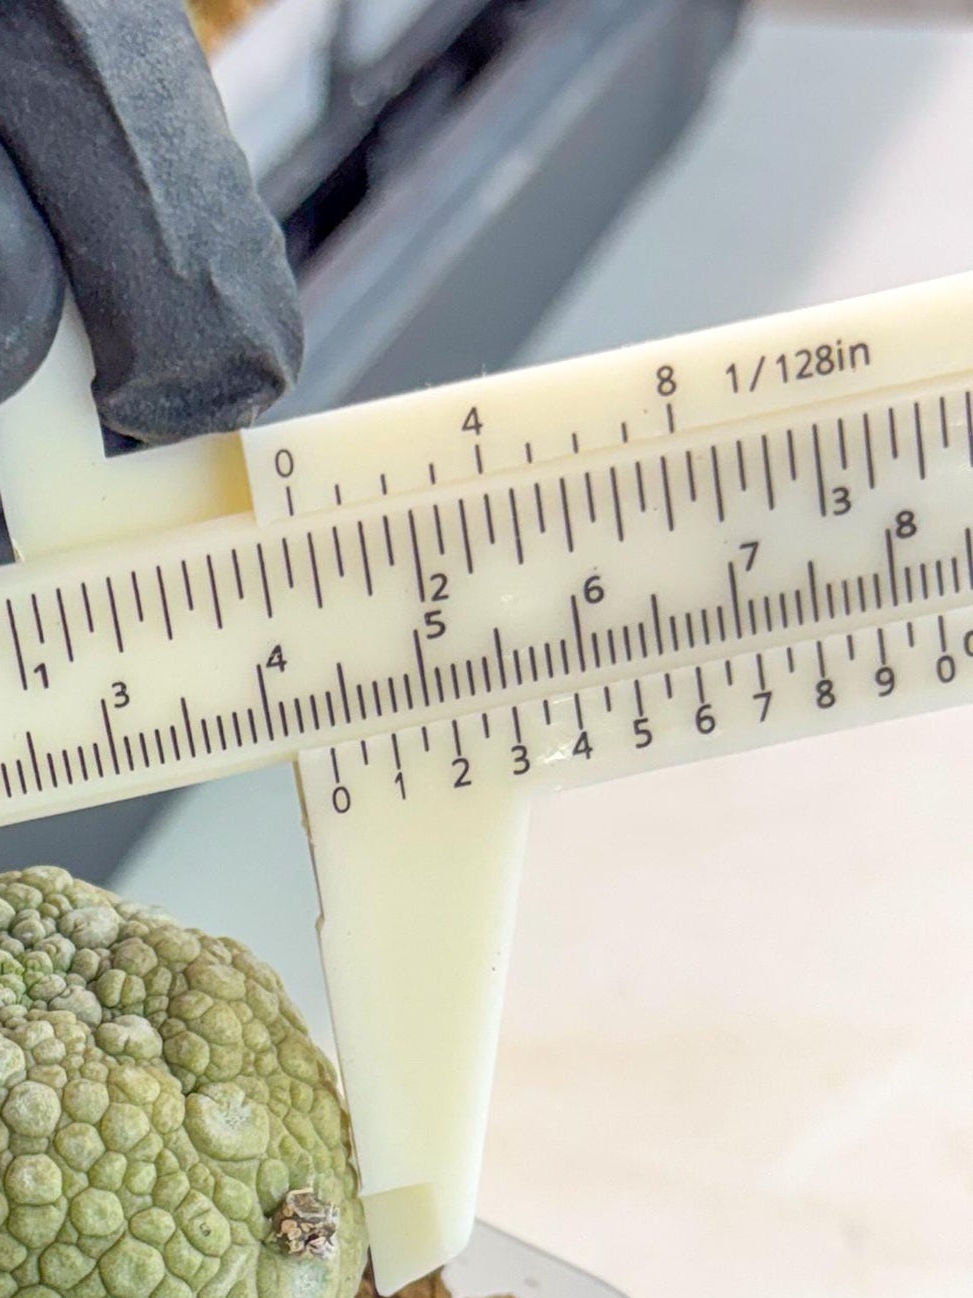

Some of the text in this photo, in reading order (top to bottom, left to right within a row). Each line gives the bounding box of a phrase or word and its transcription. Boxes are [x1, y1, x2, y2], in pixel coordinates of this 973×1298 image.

[274, 448, 295, 479] 0
[461, 406, 484, 436] 4
[655, 364, 678, 397] 8
[33, 662, 50, 690] 1
[429, 572, 450, 602] 2
[832, 486, 852, 517] 3
[111, 680, 131, 709] 3
[265, 643, 288, 673] 4
[423, 609, 447, 640] 5
[582, 574, 605, 605] 6
[738, 540, 760, 572] 7
[894, 509, 918, 540] 8
[331, 654, 957, 814] 0 1 2 3 4 5 6 7 8 9 0
